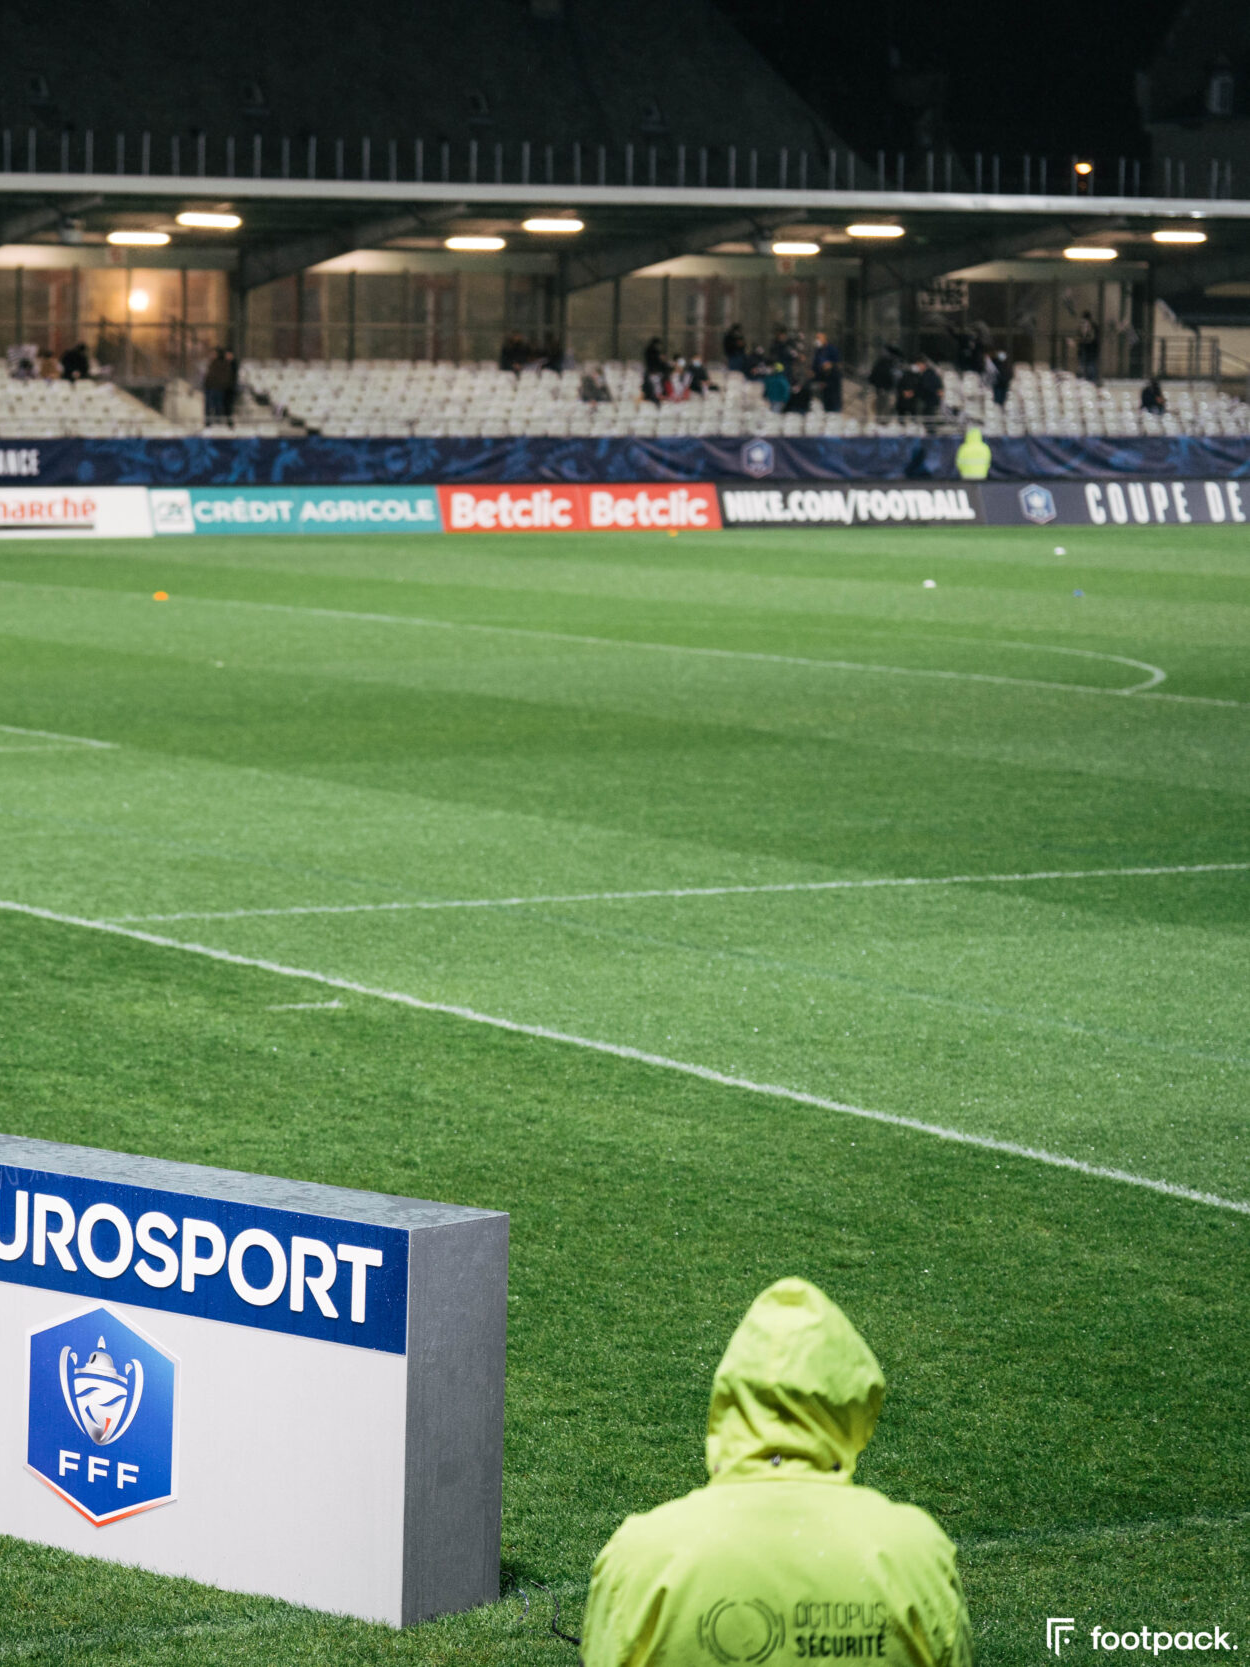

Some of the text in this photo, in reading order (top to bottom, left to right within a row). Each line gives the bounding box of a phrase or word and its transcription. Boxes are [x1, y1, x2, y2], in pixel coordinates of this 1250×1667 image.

[193, 495, 295, 523] CRÉDIT
[299, 499, 437, 522] AGRICOLE
[450, 488, 573, 529] Betclic
[589, 488, 710, 528] Betclic
[722, 488, 976, 524] NIKE.COM/FOOTBALL
[1084, 481, 1246, 525] COUPE DE
[58, 1449, 140, 1490] FFF
[795, 1602, 888, 1631] OCTOPUS
[795, 1628, 887, 1658] SÉCURITÉ
